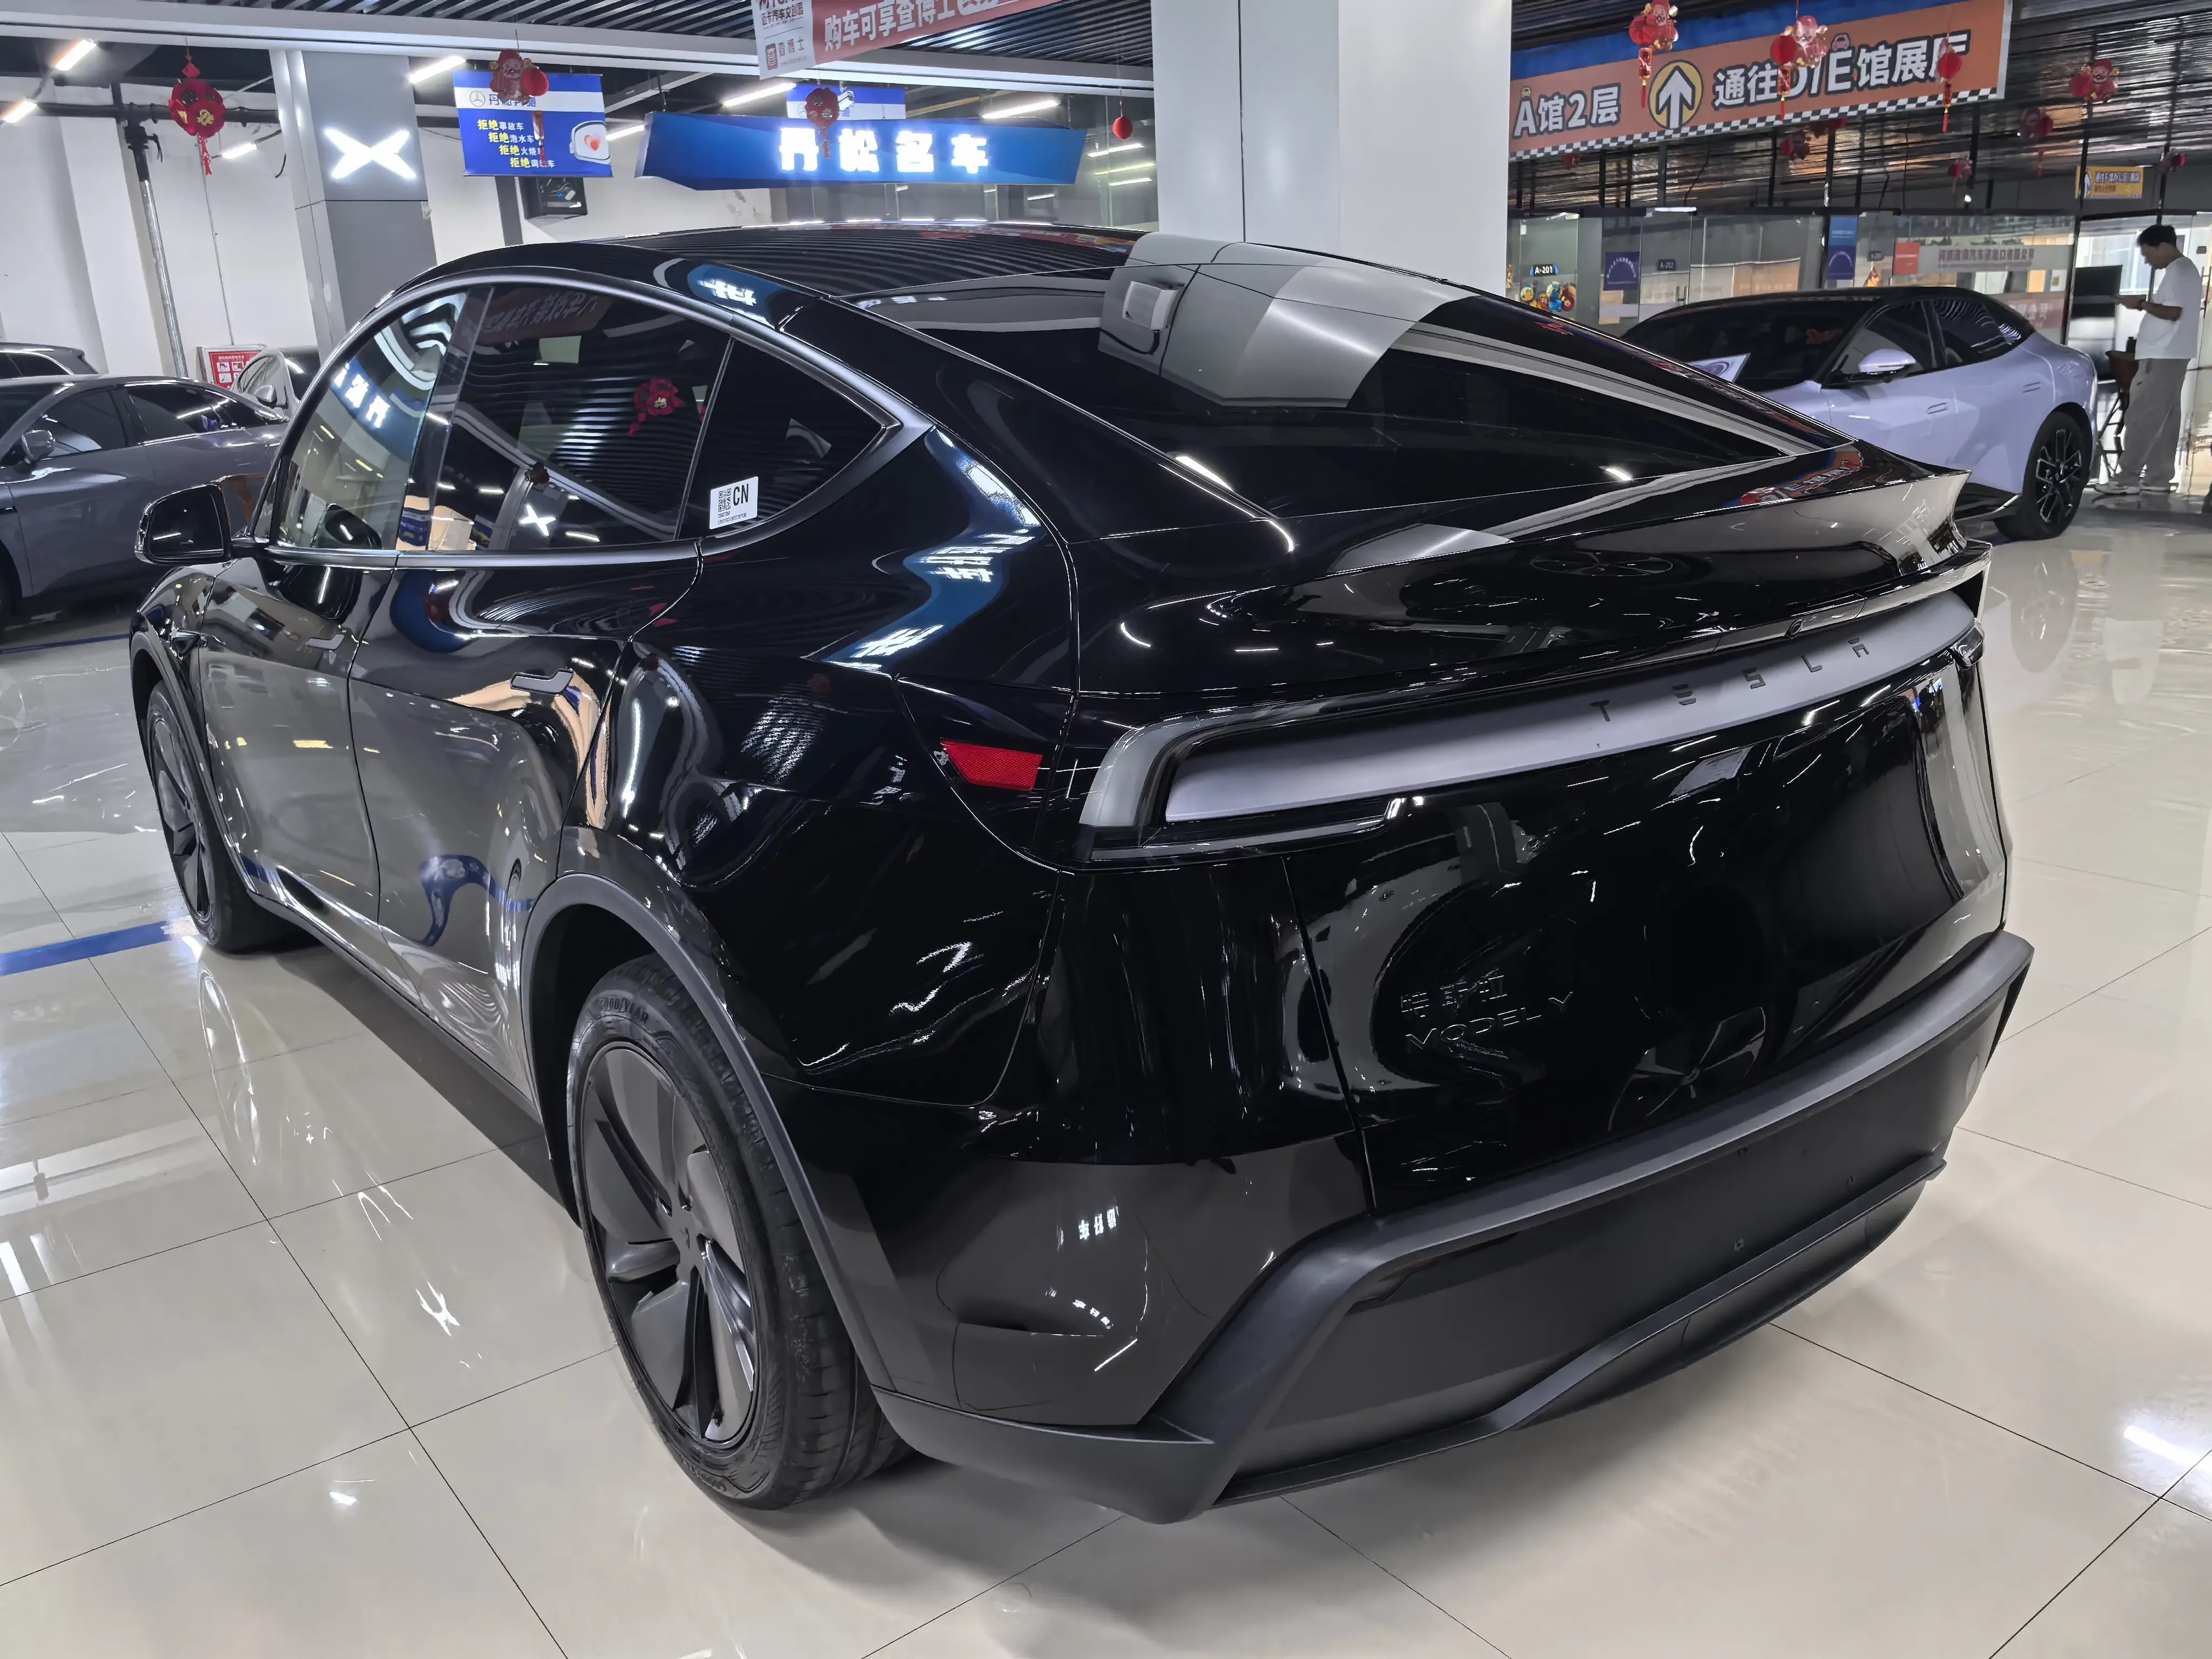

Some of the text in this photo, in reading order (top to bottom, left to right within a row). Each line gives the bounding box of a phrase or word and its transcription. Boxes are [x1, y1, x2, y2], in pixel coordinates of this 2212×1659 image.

[477, 119, 524, 131] 拒绝事故车
[1514, 86, 1620, 137] A馆2层
[1534, 265, 1553, 274] A-201
[733, 483, 749, 507] CN
[1589, 637, 1870, 722] TESLA
[1405, 991, 1574, 1053] MODEL Y
